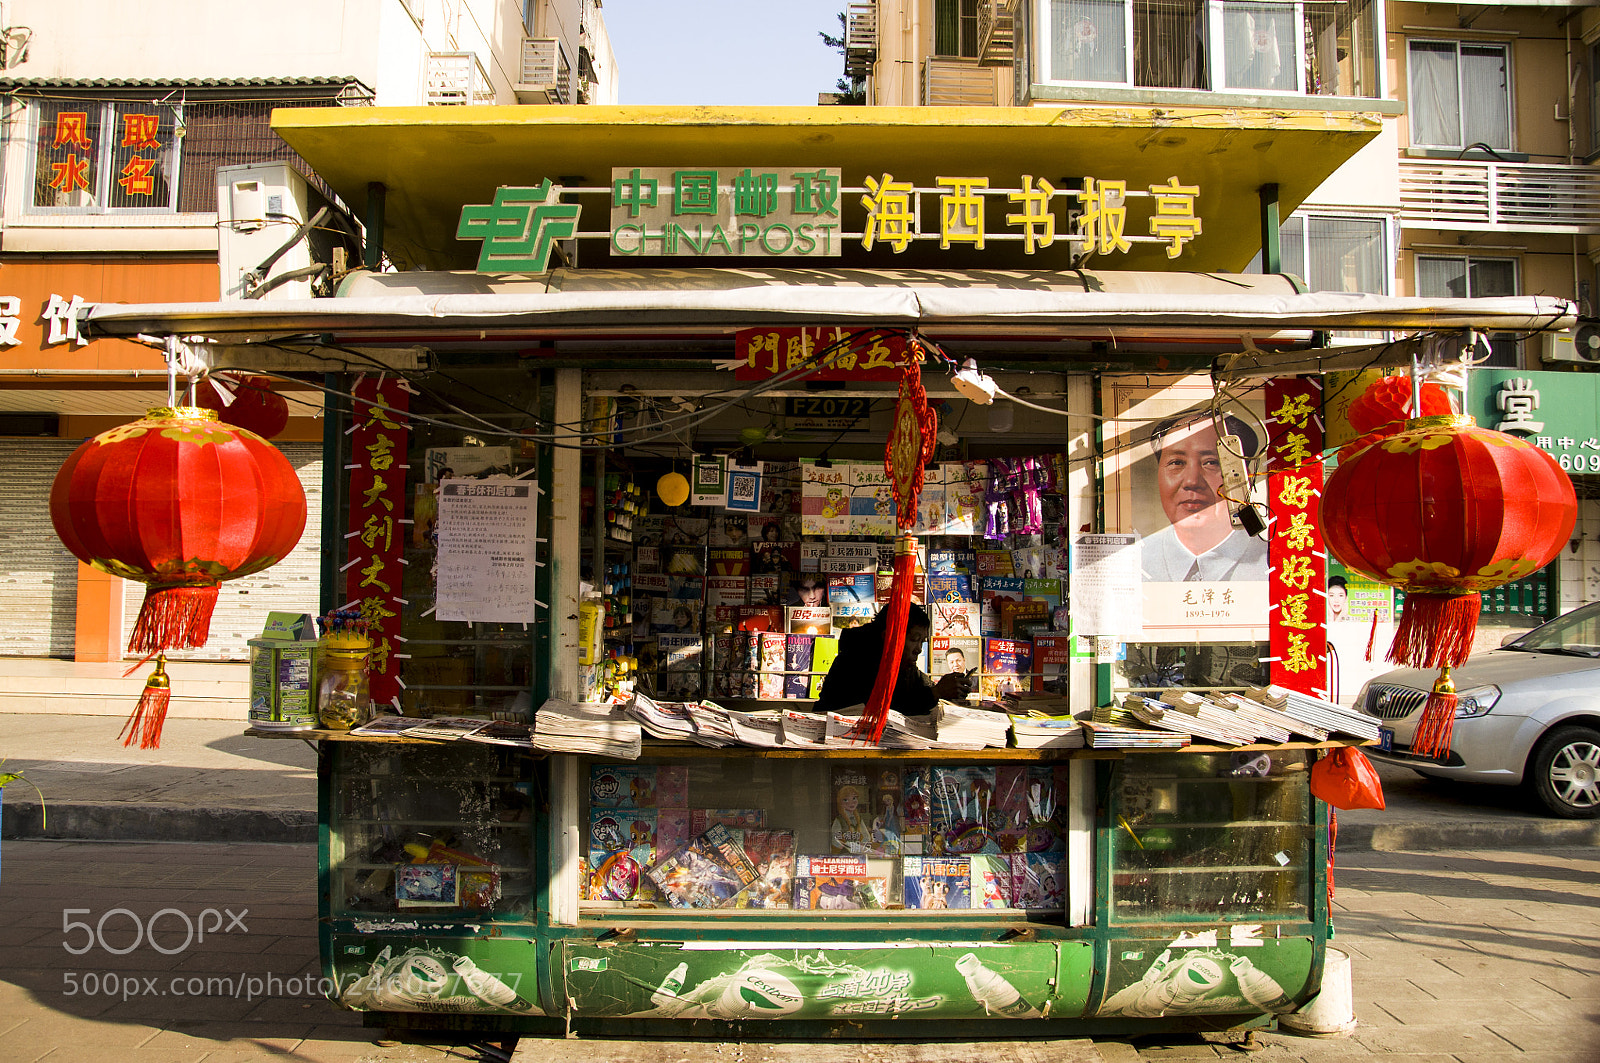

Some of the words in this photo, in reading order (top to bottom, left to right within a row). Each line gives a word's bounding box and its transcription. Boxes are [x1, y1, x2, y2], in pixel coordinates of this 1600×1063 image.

[50, 111, 93, 194] 风水
[118, 113, 161, 196] 取名
[614, 168, 839, 217] 中国邮政
[860, 173, 1203, 259] 海西书报亭
[613, 223, 733, 254] CHINA
[742, 223, 839, 254] POST
[793, 398, 864, 415] FZ072
[1495, 377, 1545, 433] 堂
[1519, 436, 1600, 450] 用中心
[837, 547, 872, 557] 兵器知识
[830, 562, 864, 572] 兵器知识
[1183, 588, 1235, 605] 毛泽东
[791, 610, 812, 619] 坦克
[811, 865, 863, 875] 迪士尼学而乐
